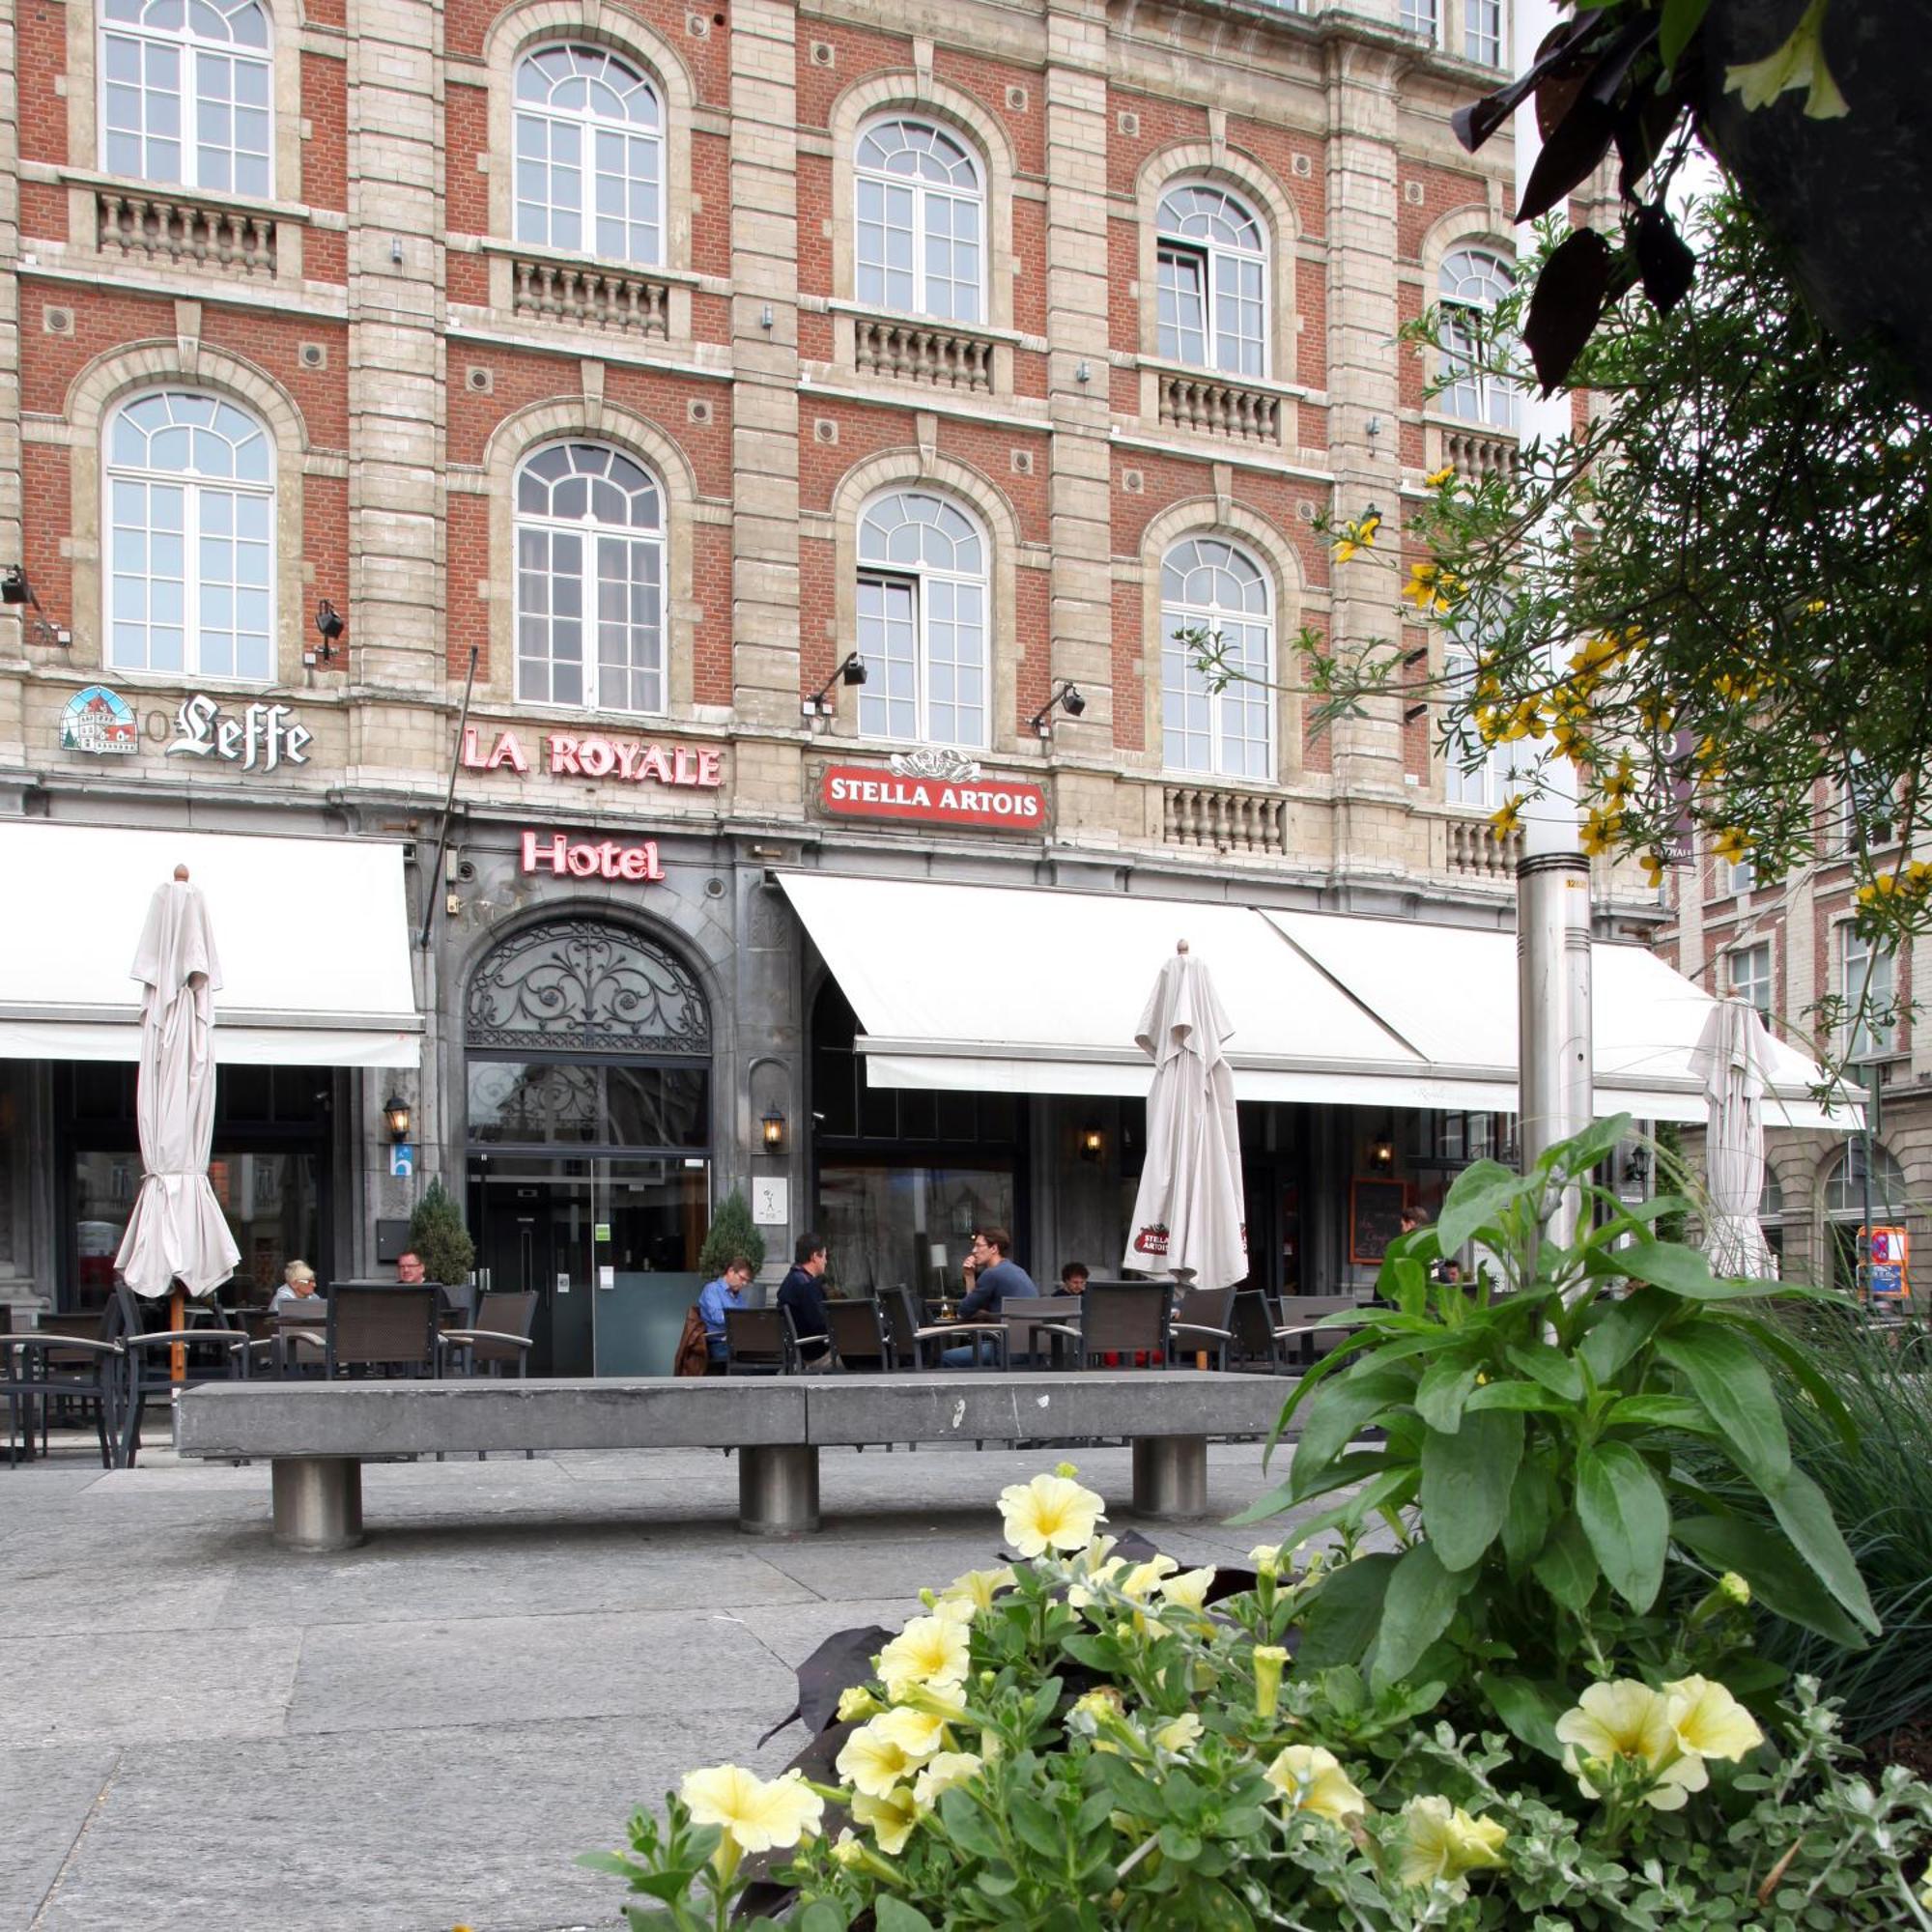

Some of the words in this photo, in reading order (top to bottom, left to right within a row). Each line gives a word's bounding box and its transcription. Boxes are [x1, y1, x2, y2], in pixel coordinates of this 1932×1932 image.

[165, 695, 314, 773] Leffe
[464, 726, 529, 772] LA
[548, 734, 724, 787] ROYALE
[831, 778, 931, 807] STELLA
[939, 788, 1038, 816] ARTOIS
[521, 831, 666, 881] Hotel
